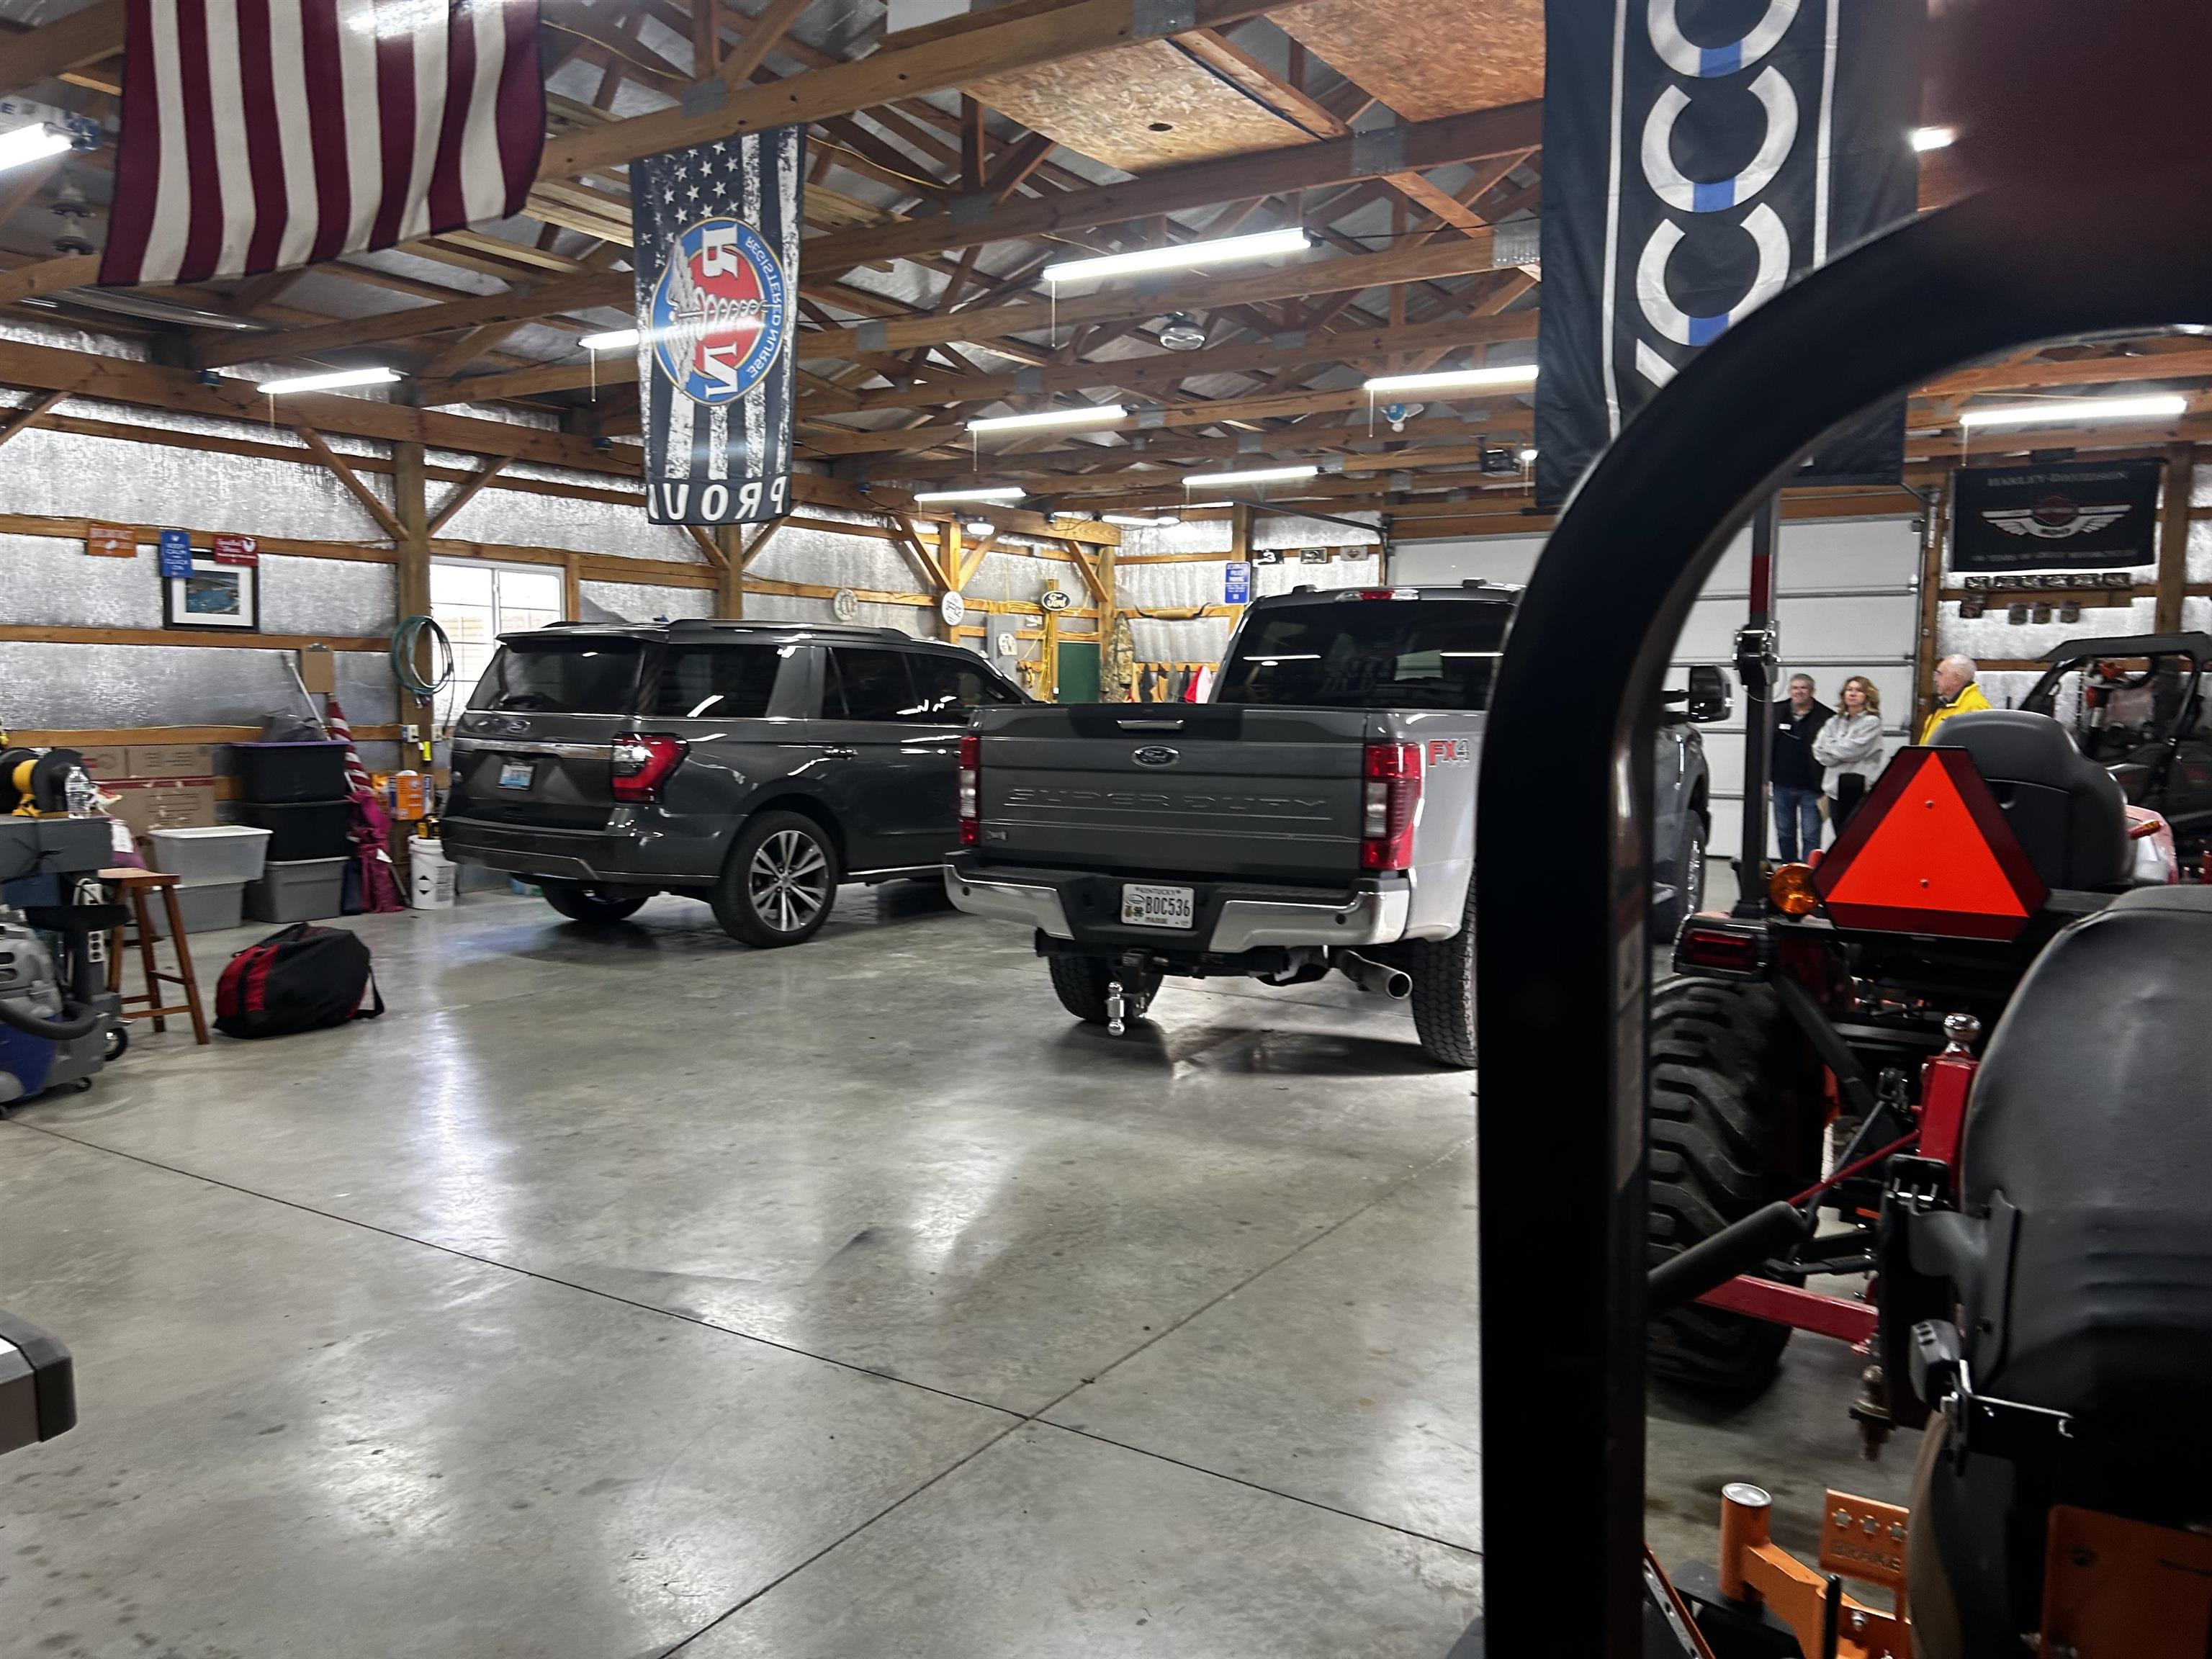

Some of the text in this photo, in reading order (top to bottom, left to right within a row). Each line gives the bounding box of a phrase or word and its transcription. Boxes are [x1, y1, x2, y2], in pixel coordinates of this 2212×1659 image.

[1046, 593, 1067, 608] Ford
[1428, 739, 1470, 768] FX4
[1008, 788, 1326, 811] SUPER DUTY
